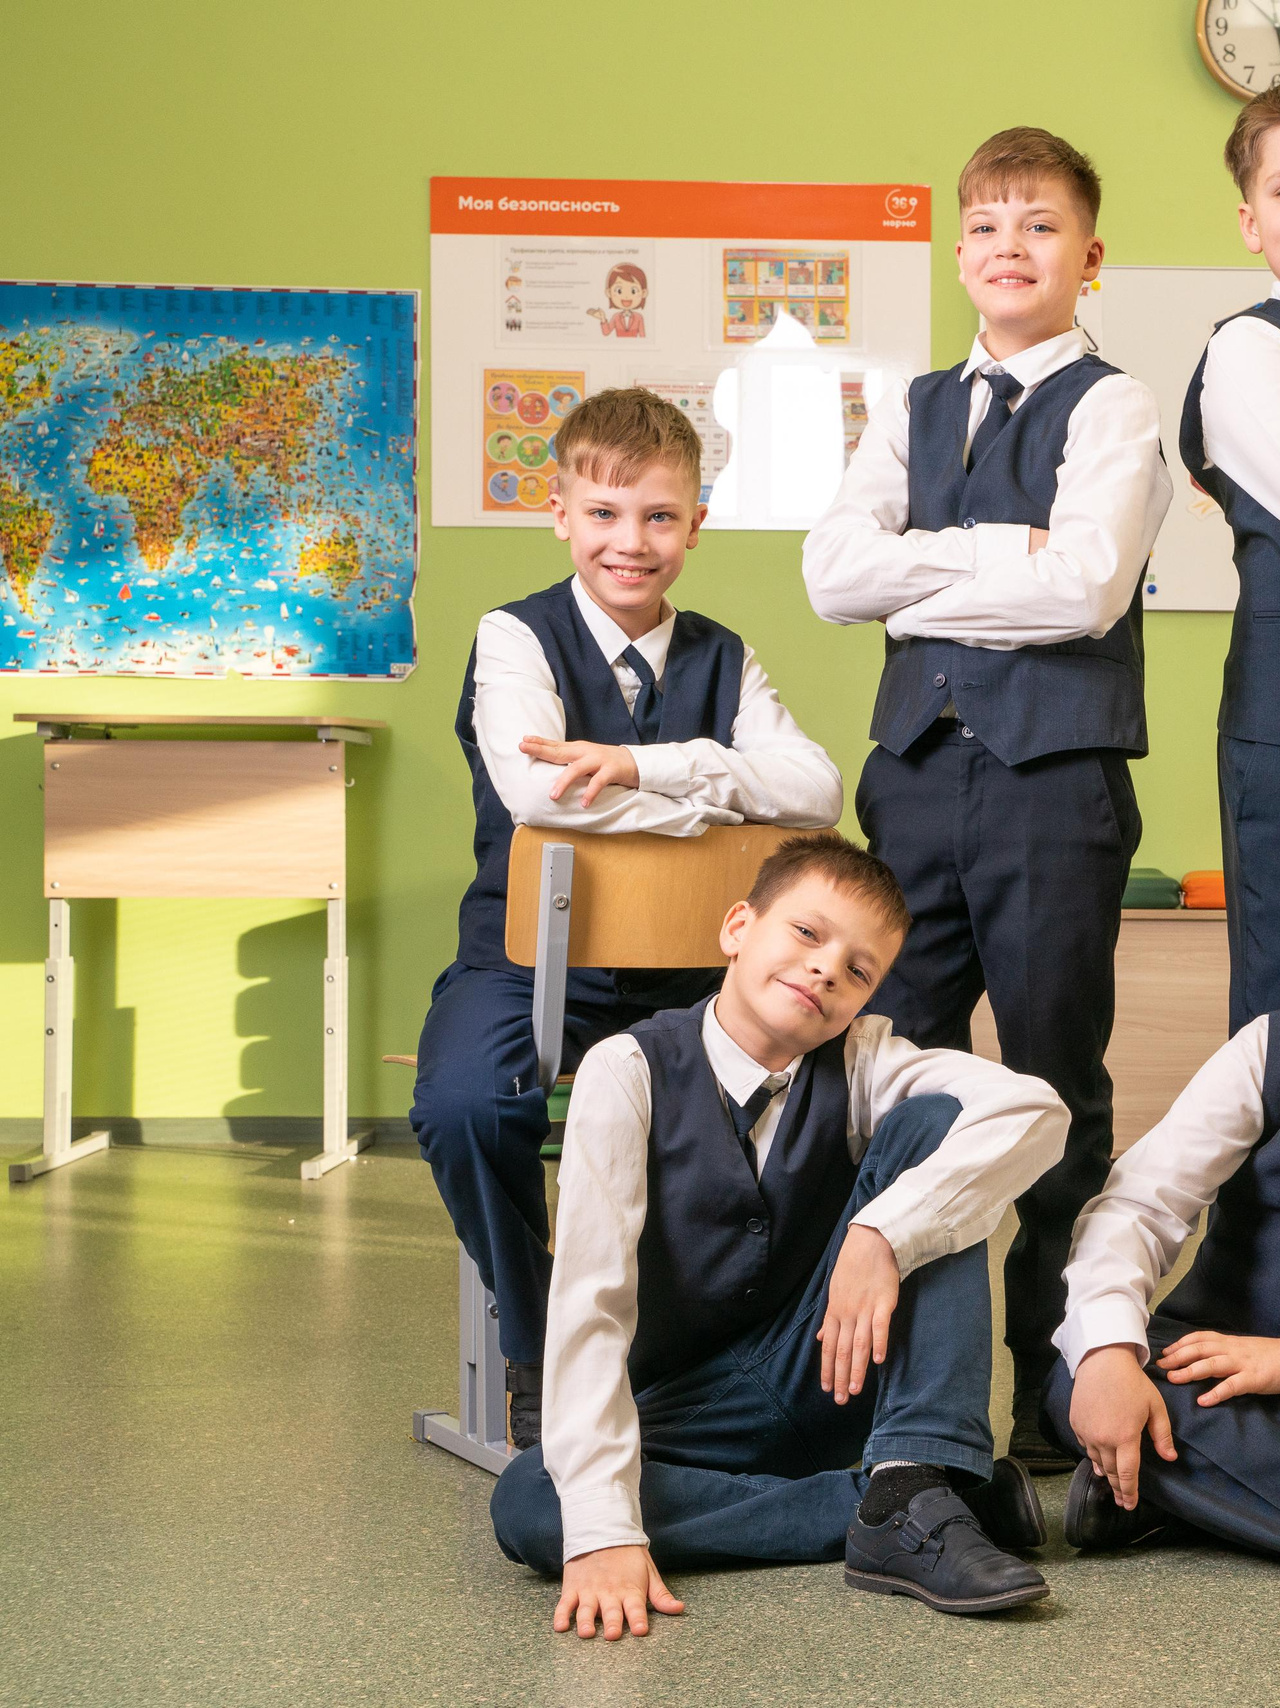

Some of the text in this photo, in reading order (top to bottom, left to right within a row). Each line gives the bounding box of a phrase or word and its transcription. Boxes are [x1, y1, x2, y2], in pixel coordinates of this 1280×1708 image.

[1215, 17, 1228, 36] 9
[1222, 44, 1236, 63] 8
[1243, 66, 1255, 84] 7
[458, 195, 620, 213] Моя безопасность
